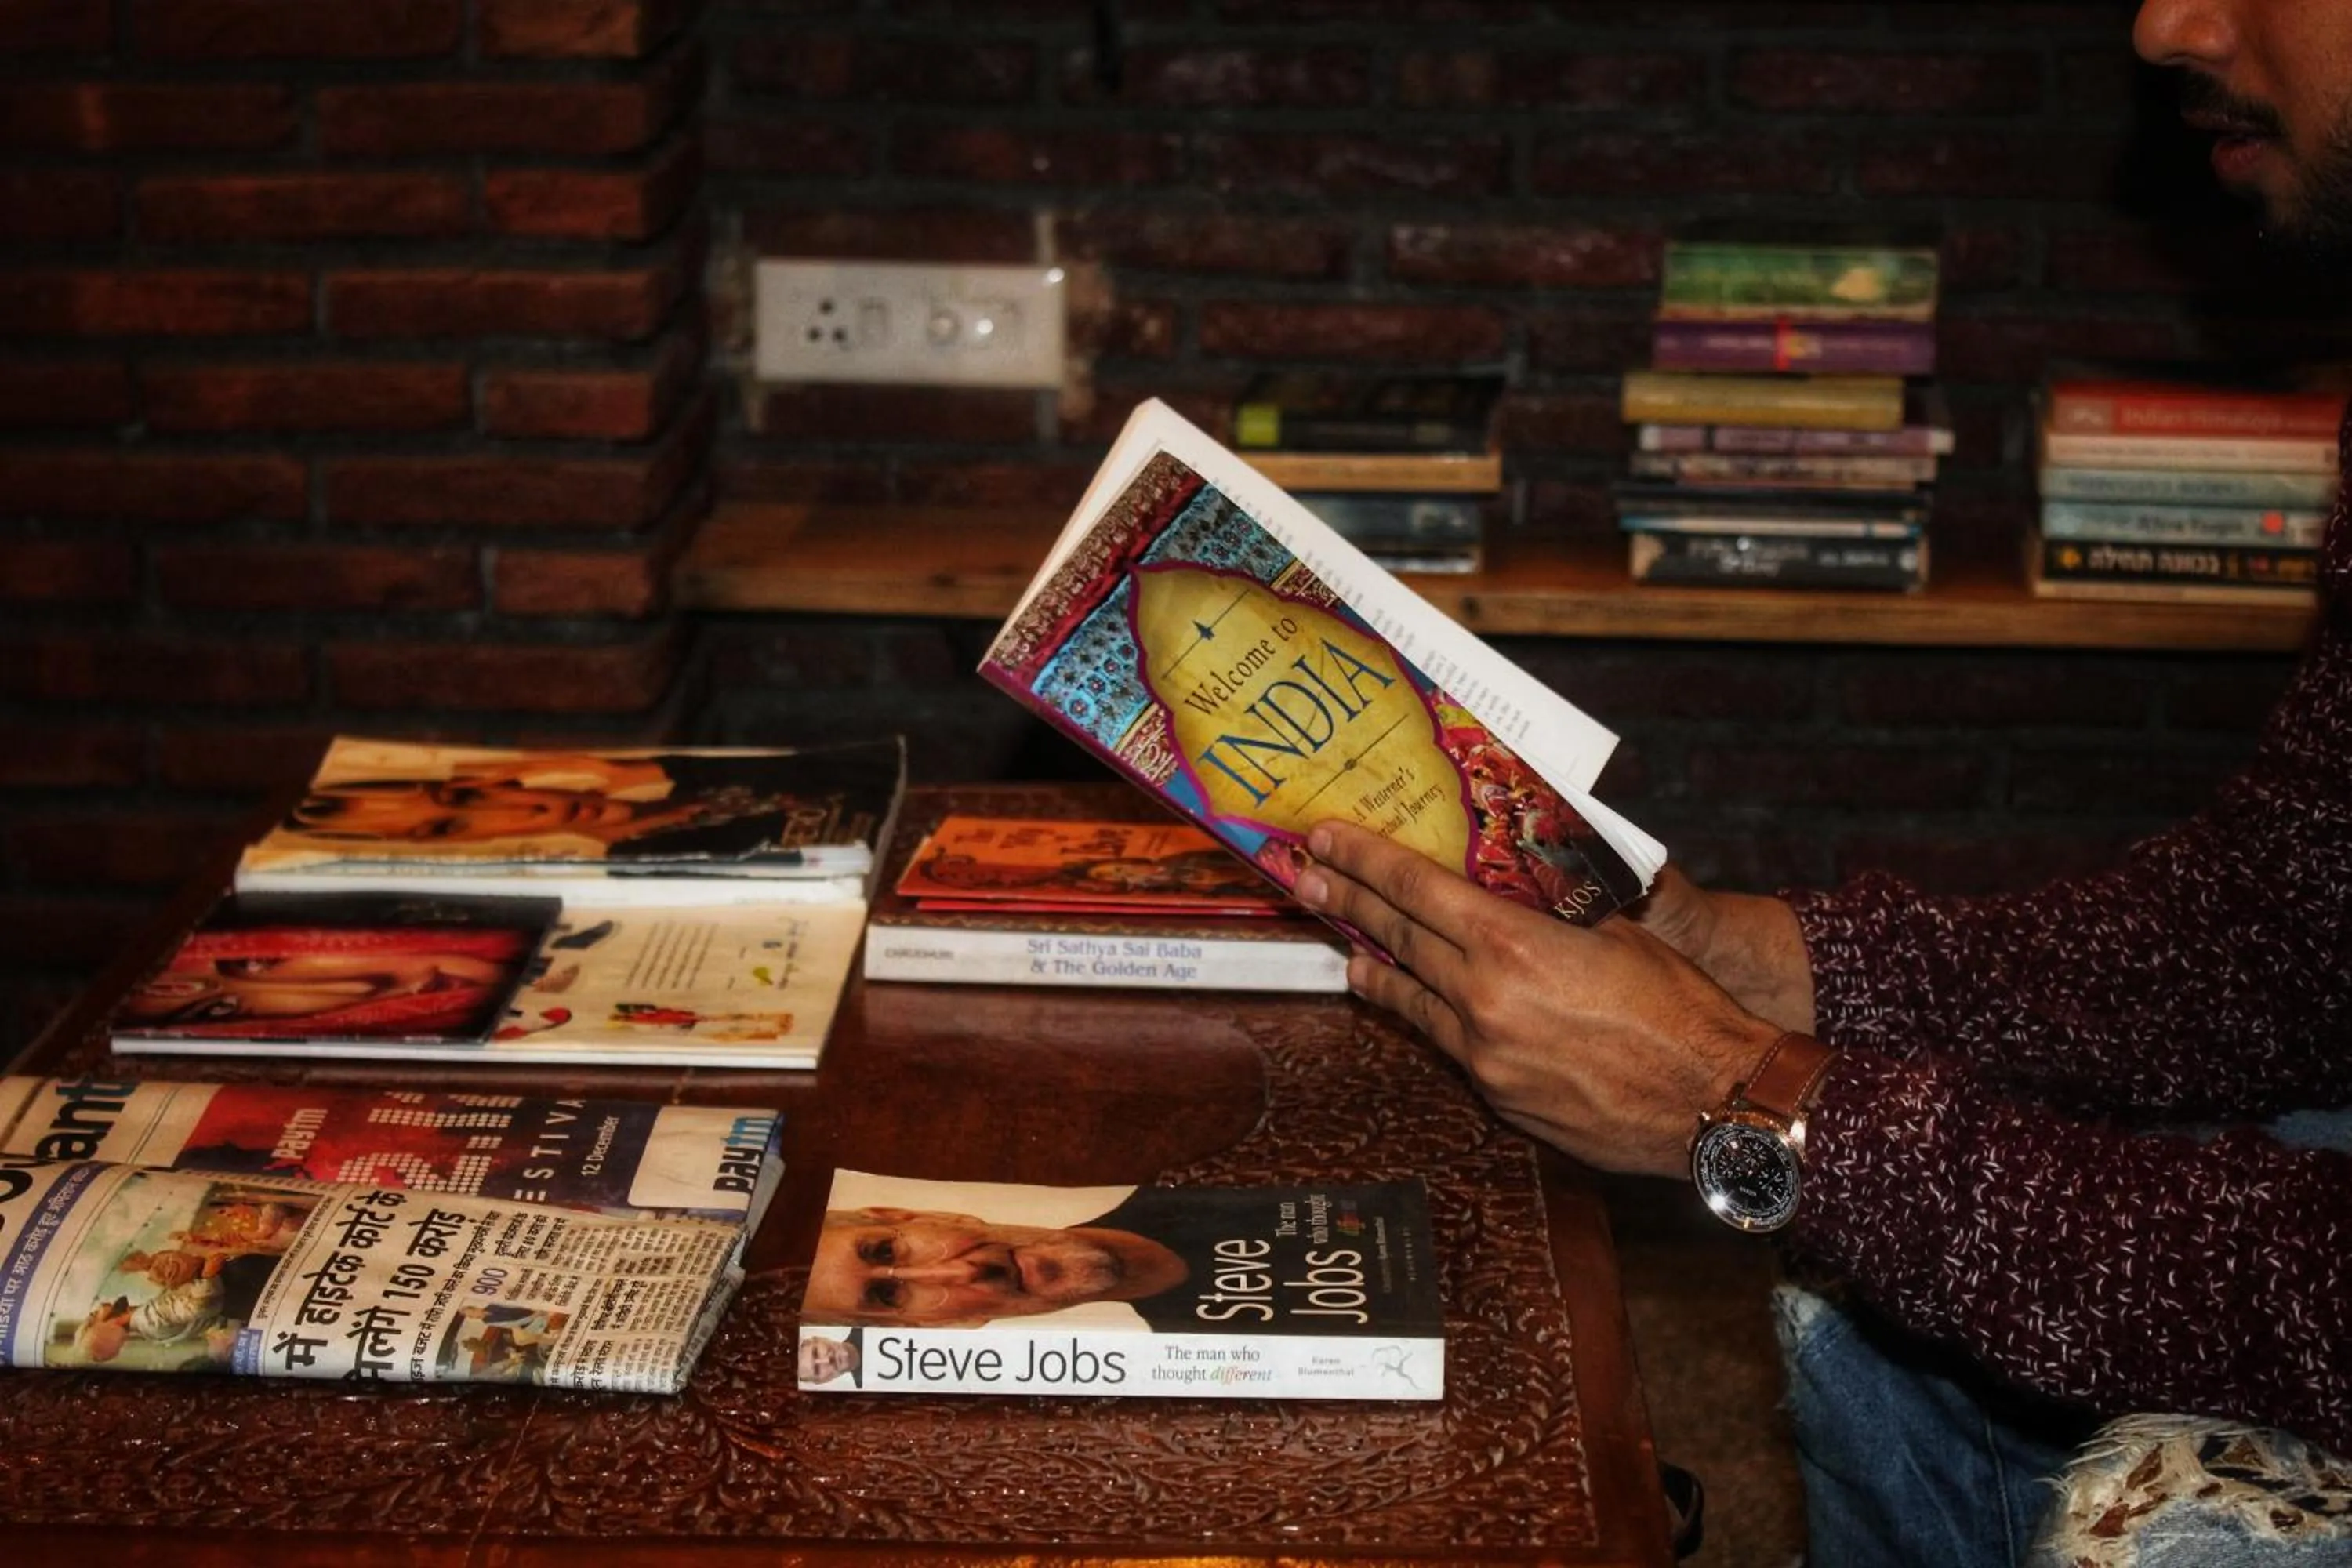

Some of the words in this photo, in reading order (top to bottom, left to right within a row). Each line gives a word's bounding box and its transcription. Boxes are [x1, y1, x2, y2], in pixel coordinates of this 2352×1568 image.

[1184, 637, 1276, 717] Welcome
[1272, 616, 1298, 643] to
[1196, 637, 1396, 808] INDIA
[1400, 784, 1446, 824] Journey
[1553, 880, 1602, 920] KJOS
[1028, 939, 1050, 954] Sri
[1057, 940, 1116, 958] Sathya
[1122, 941, 1150, 956] Sai
[1156, 942, 1202, 958] Baba
[1030, 960, 1044, 973] &
[1054, 960, 1087, 975] The
[1092, 960, 1157, 977] Golden
[1163, 962, 1198, 979] Age
[587, 1116, 620, 1163] December
[581, 1163, 601, 1177] 12
[355, 1190, 407, 1207] के
[1279, 1202, 1296, 1219] man
[1305, 1194, 1332, 1225] thought
[336, 1204, 395, 1249] कोर्ट
[407, 1209, 477, 1257] करोड़
[1275, 1221, 1298, 1237] The
[1306, 1225, 1329, 1244] who
[294, 1250, 366, 1326] हाइटेक
[383, 1264, 435, 1299] 150
[471, 1268, 508, 1296] 900
[1196, 1239, 1275, 1322] Steve
[1283, 1250, 1368, 1324] Jobs
[273, 1331, 328, 1370] में
[413, 1331, 432, 1356] बजट
[1165, 1345, 1192, 1361] The
[1196, 1349, 1226, 1363] man
[1230, 1346, 1261, 1363] who
[877, 1337, 1003, 1381] Steve
[1015, 1338, 1127, 1384] Jobs
[1152, 1367, 1207, 1385] thought
[1210, 1367, 1273, 1385] different
[1298, 1367, 1355, 1377] Blumenthal
[1312, 1356, 1341, 1365] Karen
